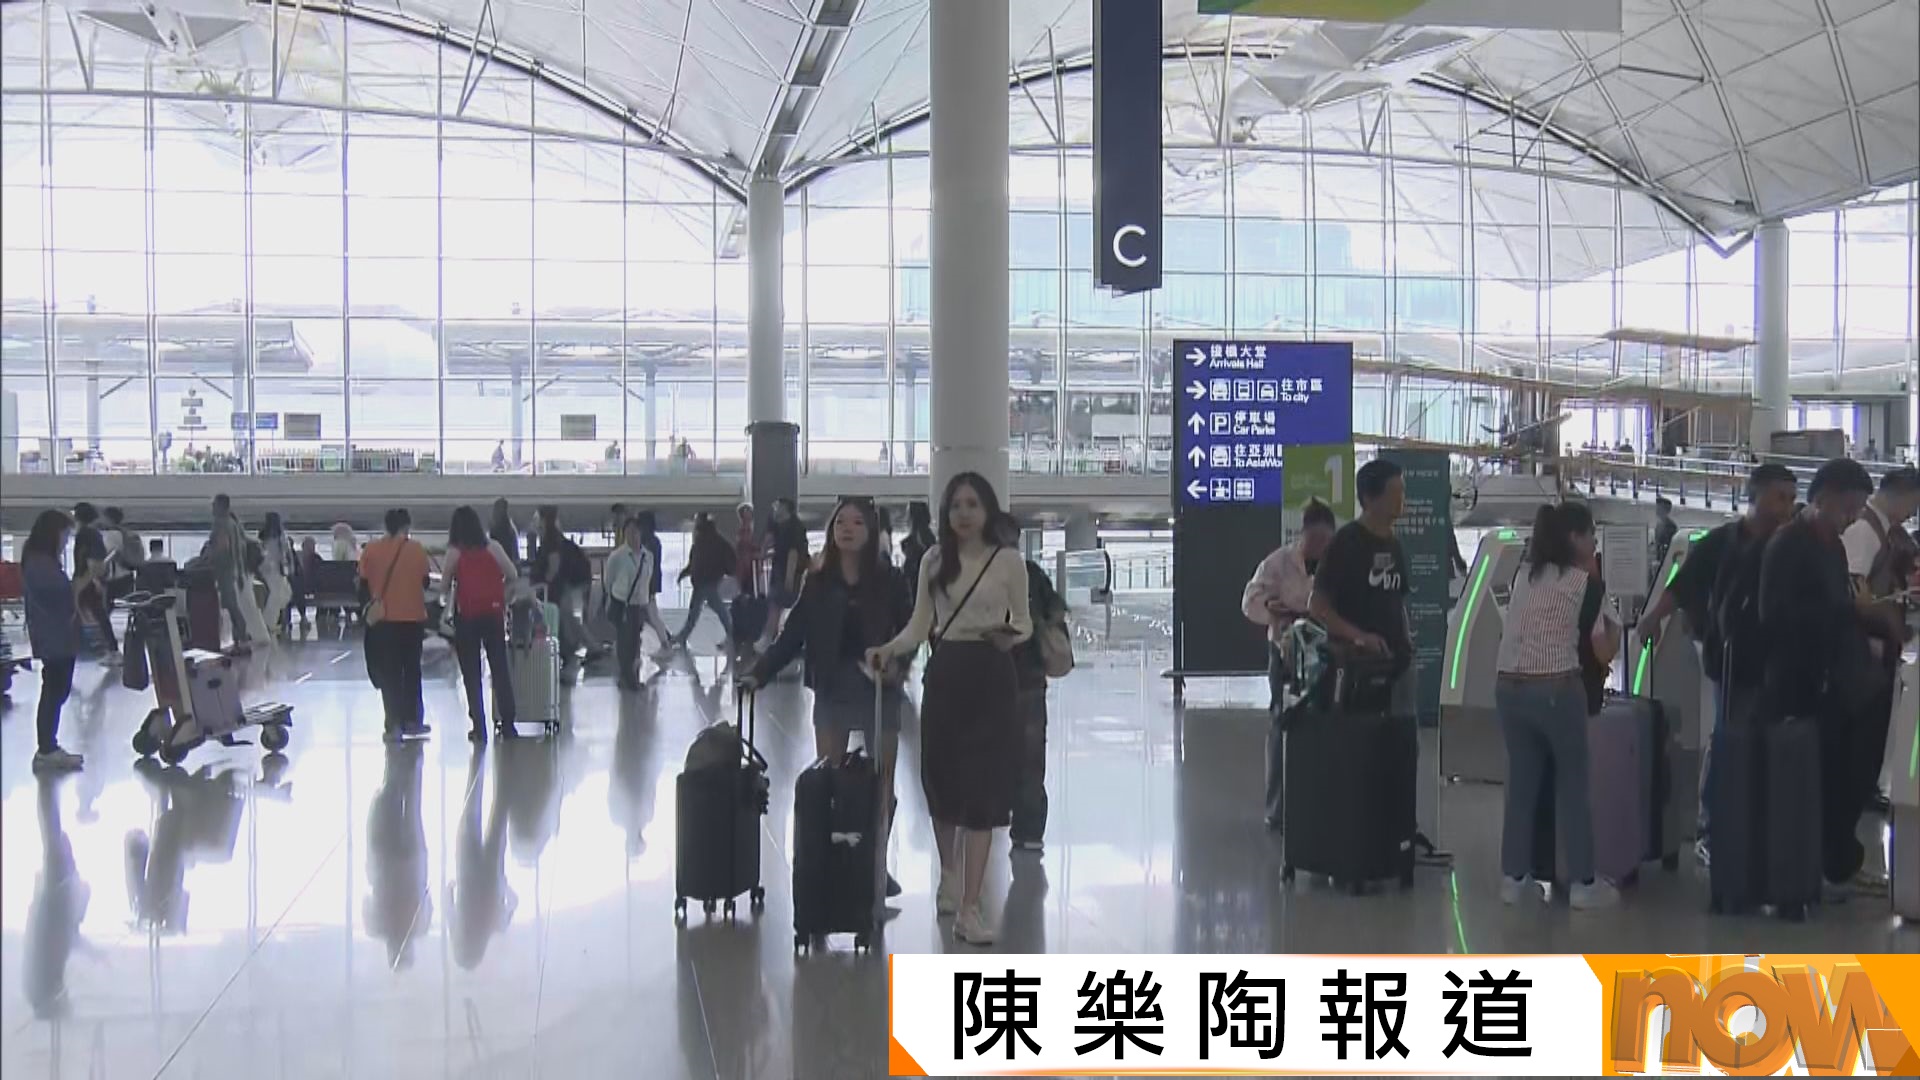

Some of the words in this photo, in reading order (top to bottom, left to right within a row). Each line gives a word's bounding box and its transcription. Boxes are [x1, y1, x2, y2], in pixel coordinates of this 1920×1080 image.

[1112, 224, 1147, 268] C
[1209, 358, 1245, 369] Arrivals
[1246, 358, 1264, 369] Hall
[1281, 377, 1323, 392] 往市區
[1280, 392, 1292, 401] To
[1293, 392, 1310, 404] city
[1234, 410, 1276, 425] 停車場
[1233, 424, 1249, 435] Car
[1251, 424, 1276, 435] Parks
[1234, 458, 1245, 468] To
[1324, 455, 1343, 504] 1
